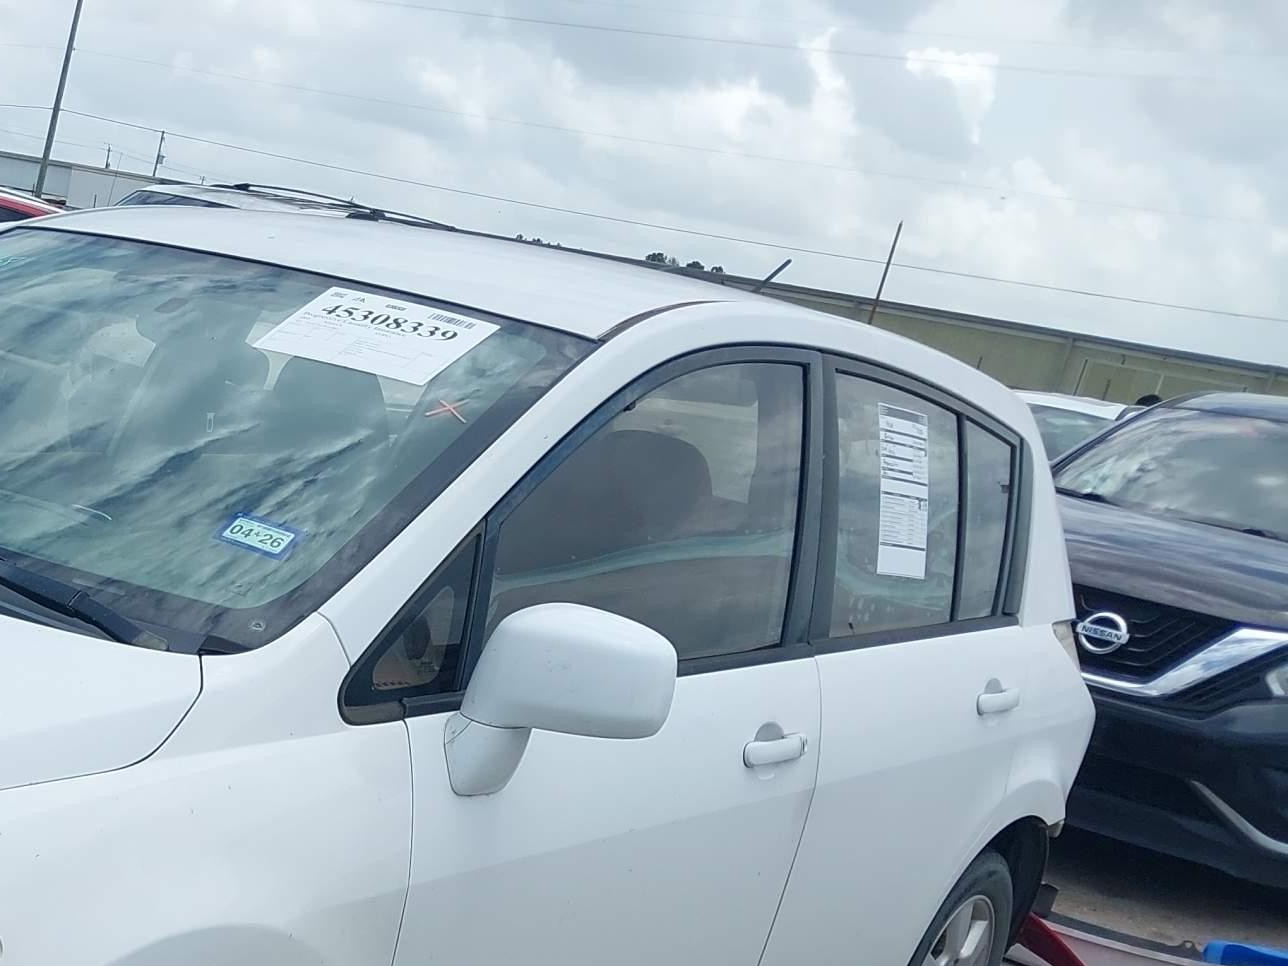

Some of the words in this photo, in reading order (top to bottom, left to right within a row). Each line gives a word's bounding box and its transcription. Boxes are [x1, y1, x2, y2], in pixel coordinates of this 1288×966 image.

[321, 303, 458, 341] 45308339
[229, 524, 254, 538] 04
[258, 533, 285, 548] 26
[1081, 625, 1122, 641] NISSAN
